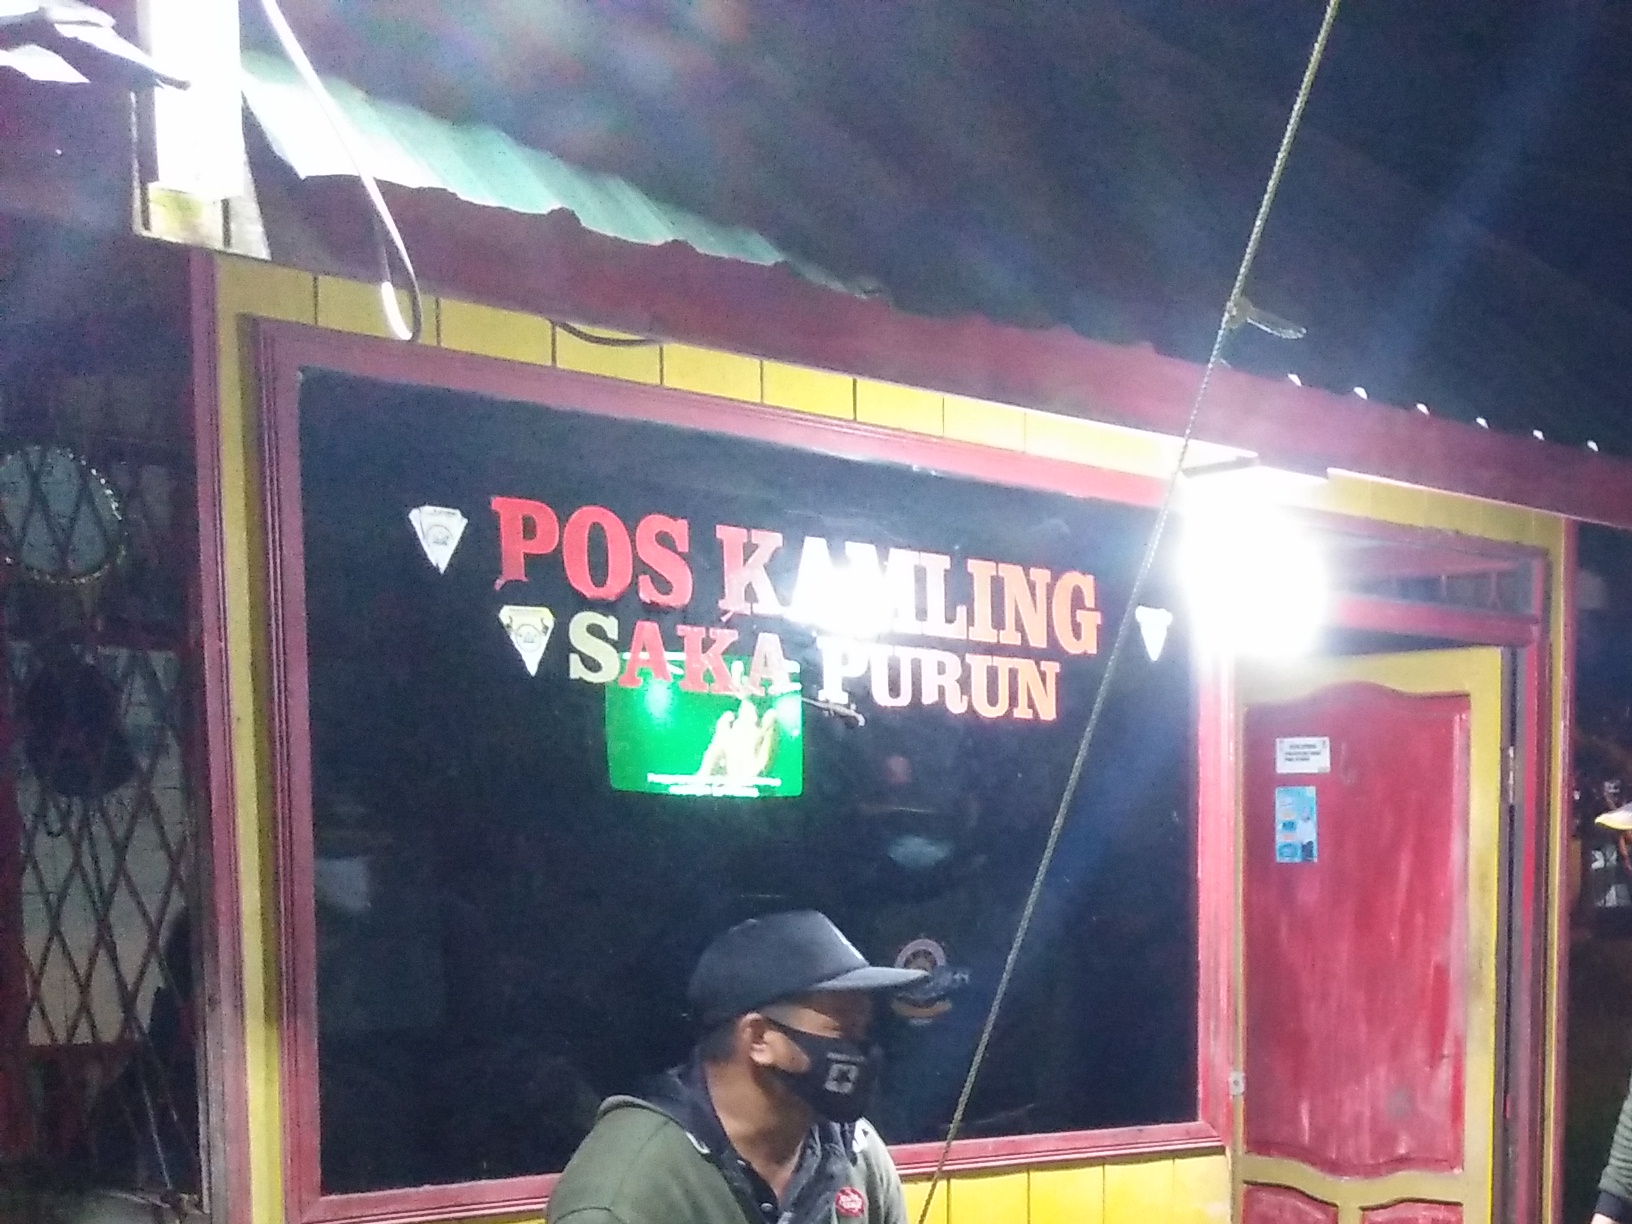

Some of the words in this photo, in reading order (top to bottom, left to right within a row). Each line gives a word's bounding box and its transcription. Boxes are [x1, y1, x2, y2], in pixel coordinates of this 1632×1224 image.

[490, 496, 694, 610] POS
[716, 524, 1101, 655] KAMLING
[569, 610, 800, 698] SAKA
[816, 634, 1061, 721] PURUN
